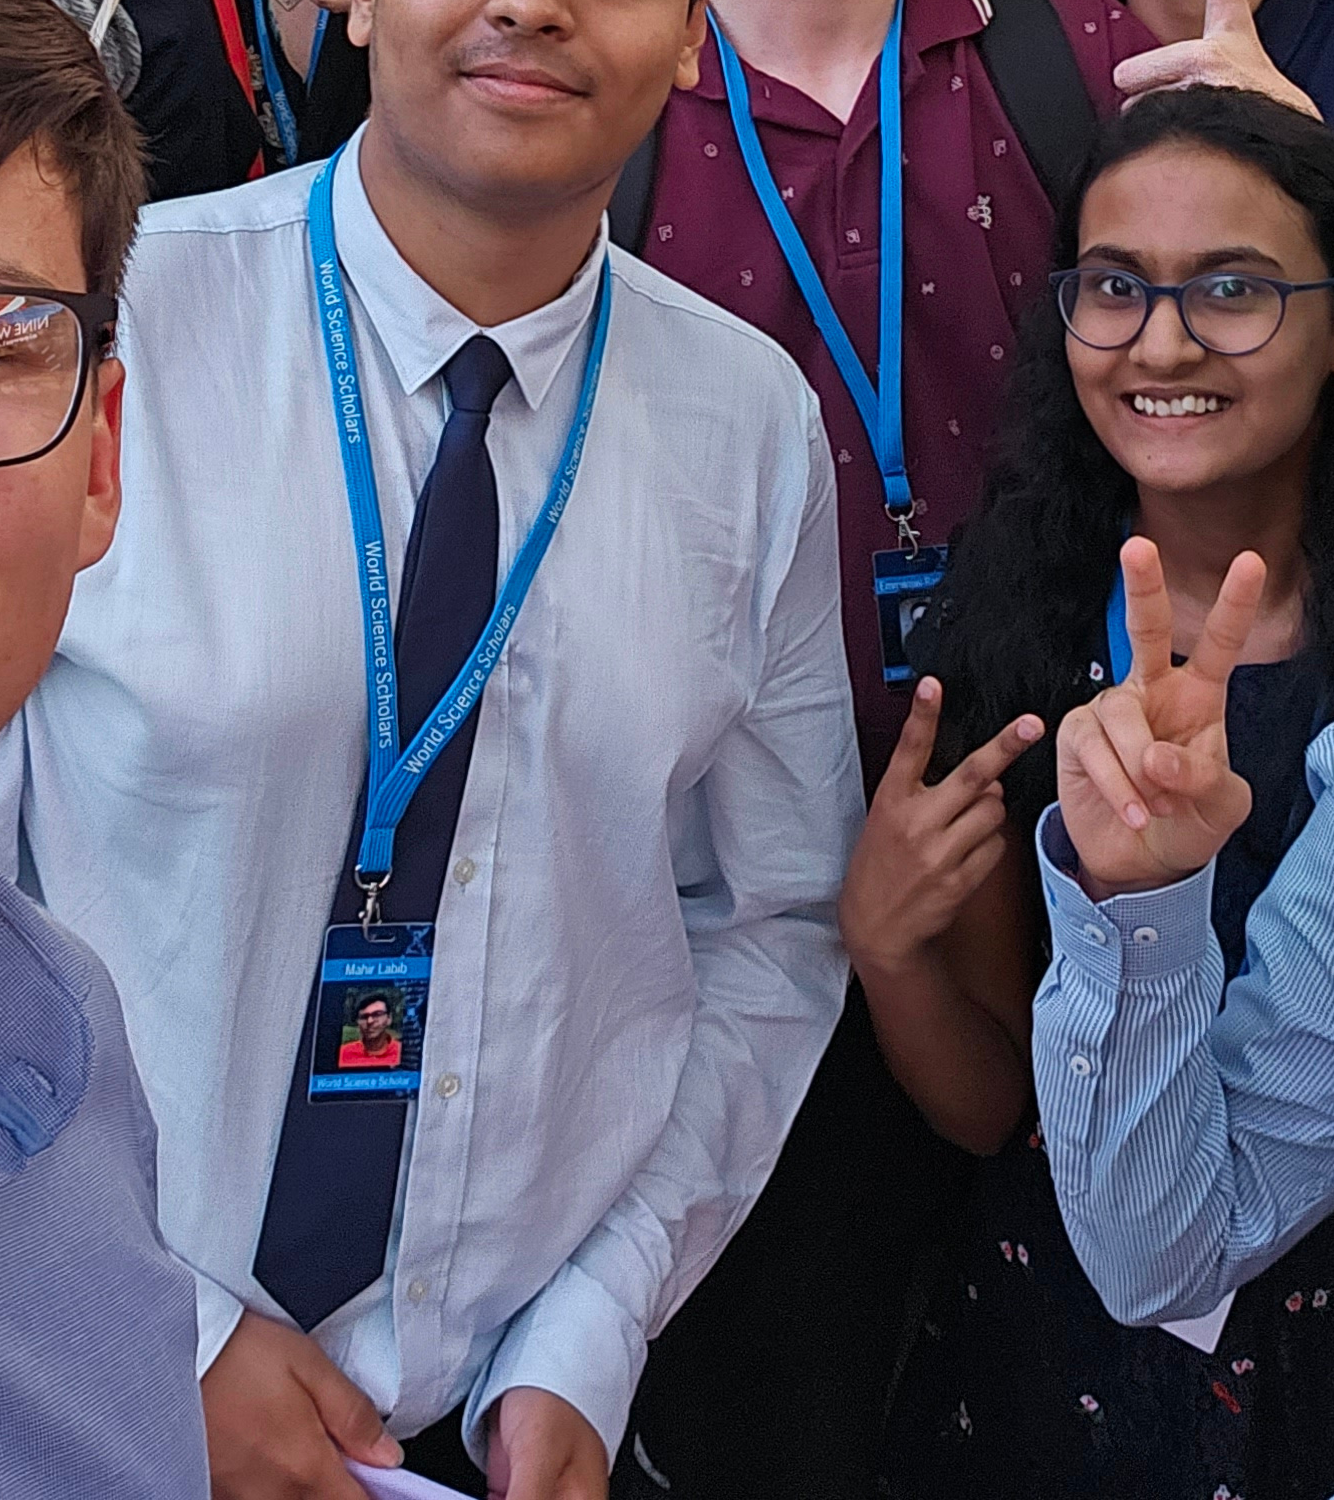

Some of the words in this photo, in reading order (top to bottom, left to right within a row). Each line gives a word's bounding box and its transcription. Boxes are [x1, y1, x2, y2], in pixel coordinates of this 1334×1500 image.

[319, 259, 341, 306] World
[327, 308, 350, 373] Science
[338, 375, 361, 444] Scholars
[547, 479, 571, 524] World
[565, 424, 586, 480] Science
[364, 540, 386, 592] World
[371, 597, 389, 668] Science
[376, 671, 393, 749] Scholars
[403, 727, 445, 775] World
[437, 669, 485, 731] Science
[478, 603, 517, 668] Scholars
[345, 963, 374, 975] Mahir
[378, 962, 408, 975] Labib
